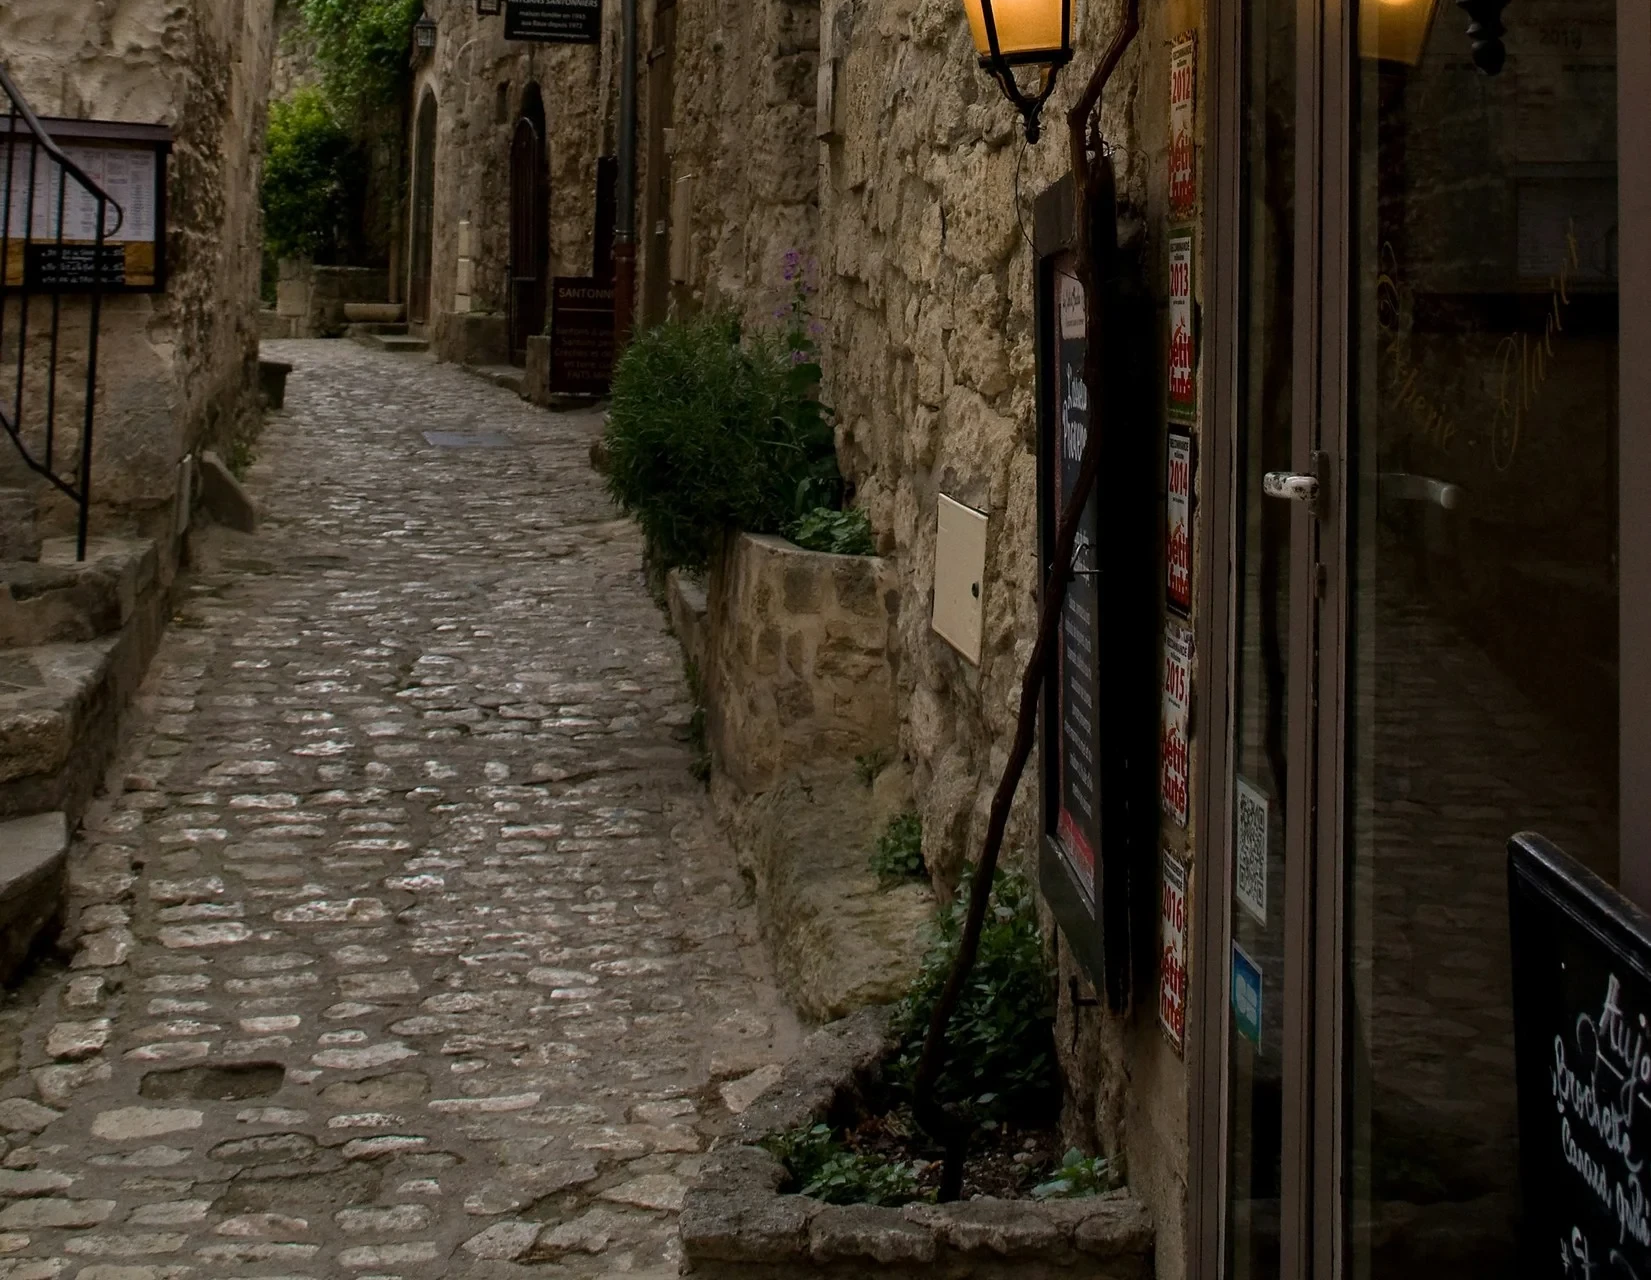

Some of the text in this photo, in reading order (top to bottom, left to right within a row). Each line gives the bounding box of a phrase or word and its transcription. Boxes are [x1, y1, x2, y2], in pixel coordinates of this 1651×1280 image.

[1172, 66, 1191, 104] 2012
[1170, 263, 1189, 296] 2013
[1169, 460, 1188, 497] 2014
[1165, 657, 1185, 702] 2015
[1163, 880, 1182, 933] 2016
